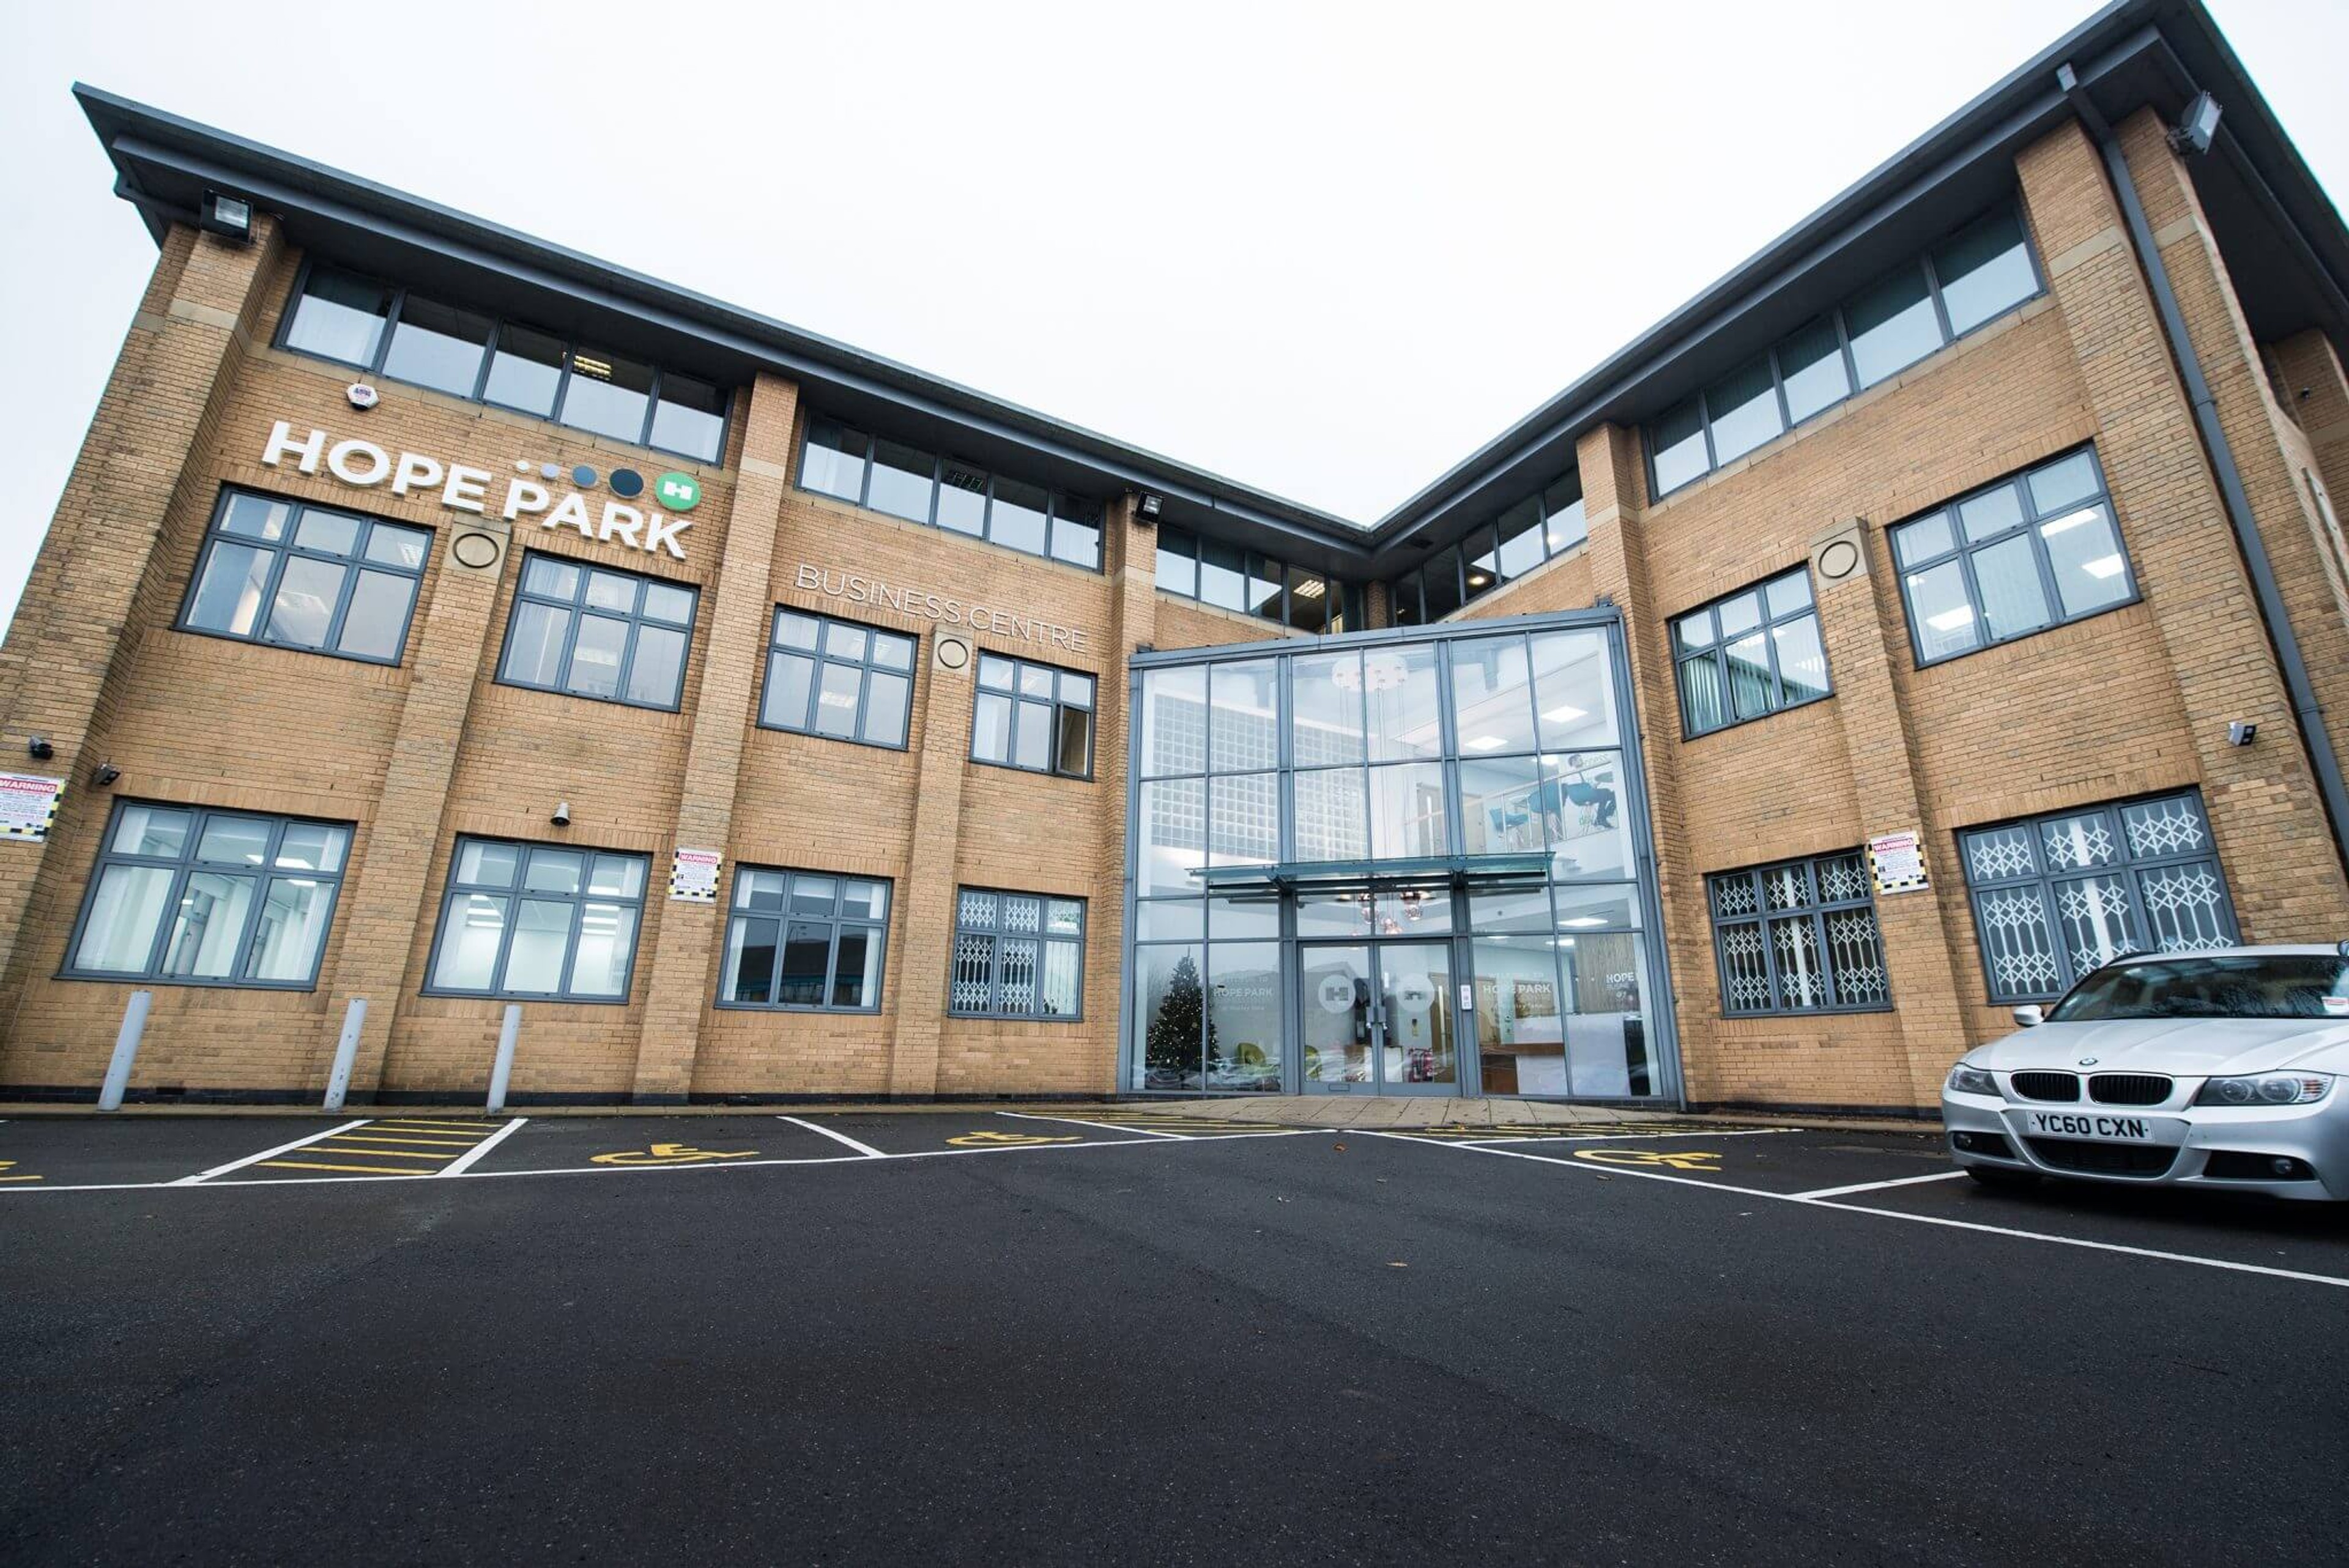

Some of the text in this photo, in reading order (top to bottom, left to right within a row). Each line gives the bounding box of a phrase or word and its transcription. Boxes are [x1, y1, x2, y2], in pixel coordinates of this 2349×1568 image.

[262, 420, 693, 560] HOPE PARK
[796, 565, 1087, 654] BUSINESS CENTRE
[1483, 984, 1551, 994] HOE PARK
[1606, 972, 1634, 983] HOPE
[2036, 1113, 2145, 1137] YC60 CXN
